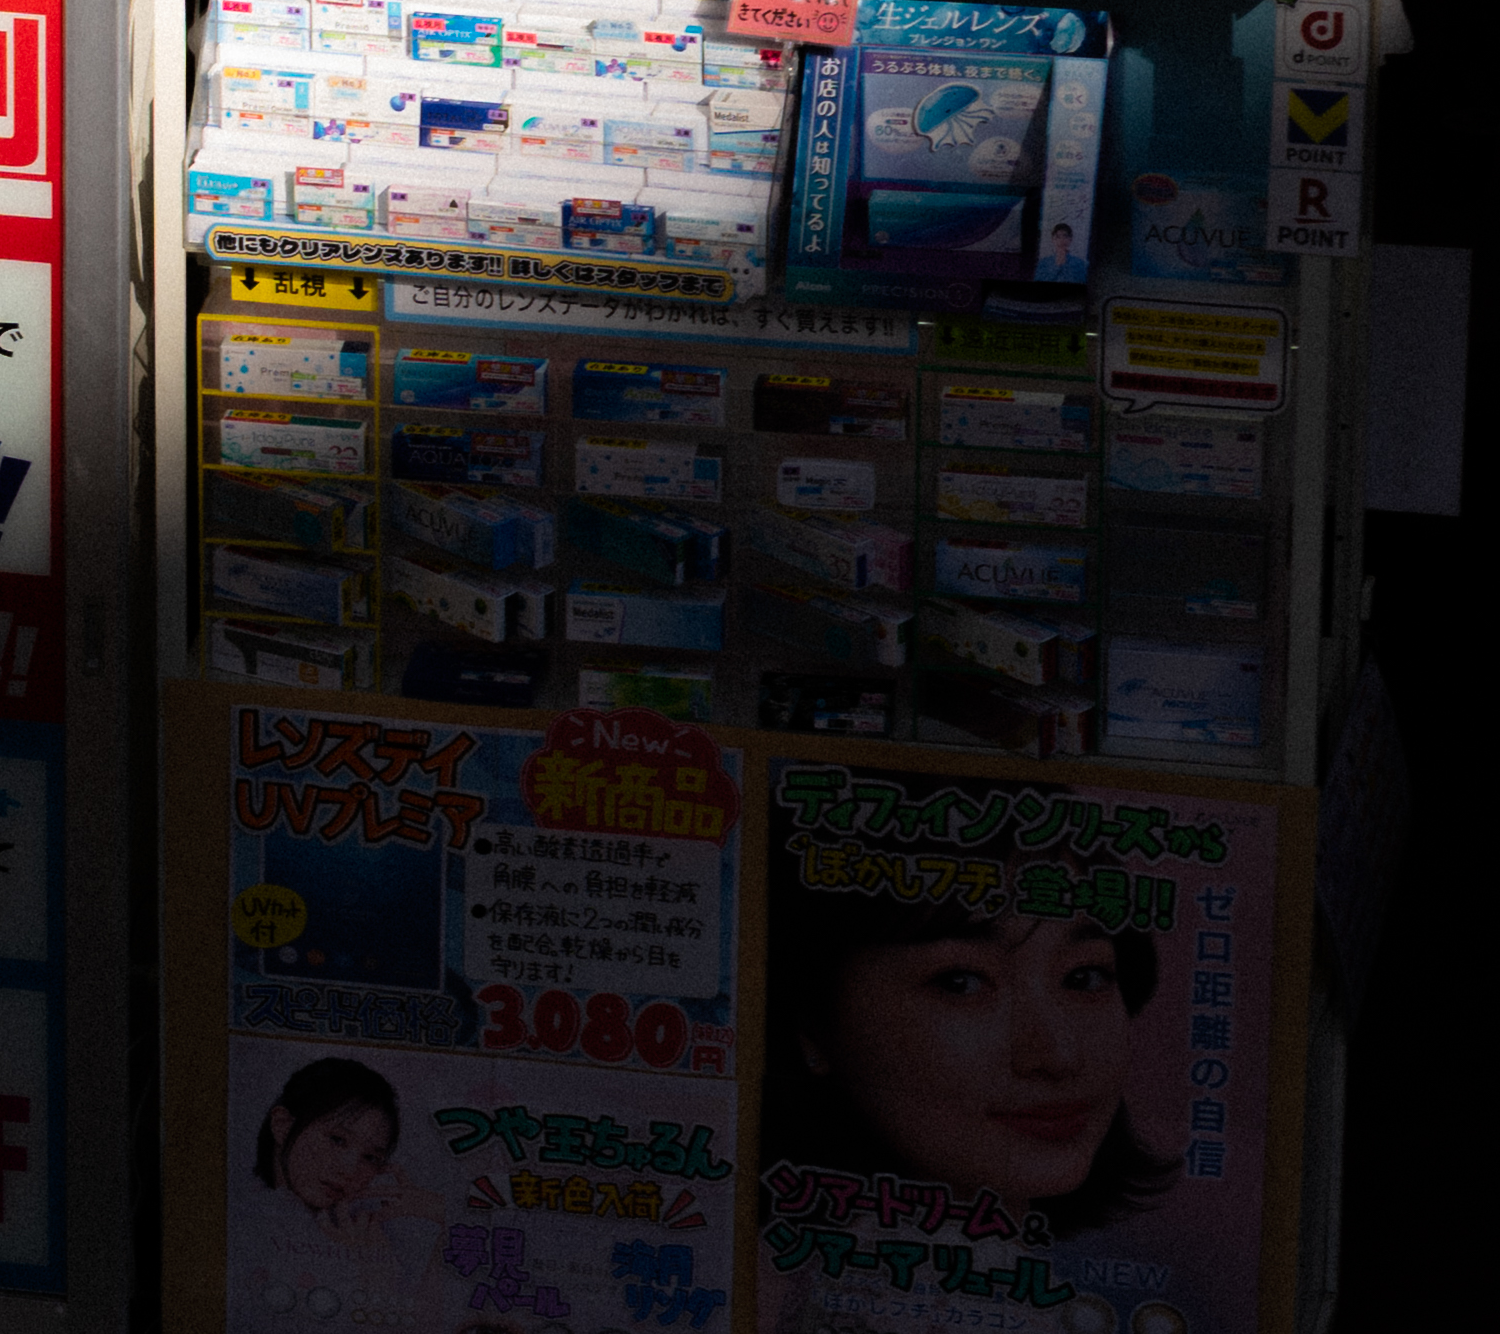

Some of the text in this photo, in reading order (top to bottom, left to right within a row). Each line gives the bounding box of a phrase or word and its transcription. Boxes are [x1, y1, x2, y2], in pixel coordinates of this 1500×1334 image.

[737, 3, 811, 30] きてください
[873, 1, 1050, 37] 生ジェルレンズ
[804, 57, 843, 254] お店の人は知ってるよ
[1285, 147, 1347, 166] POINT
[1278, 226, 1349, 249] POINT
[274, 270, 326, 298] 乱視
[961, 328, 1060, 355] 遠近両用
[237, 708, 478, 789] レンズデイ
[591, 718, 673, 755] New
[235, 778, 485, 851] UVプレミア
[534, 750, 725, 839] 新商品
[243, 896, 301, 921] UVカット
[250, 920, 279, 944] 付
[247, 985, 457, 1047] スピード価格
[1186, 885, 1235, 1178] ゼロ距離の自信
[693, 1046, 726, 1074] 円
[433, 1105, 734, 1181] つや玉ちゅるん
[509, 1168, 664, 1222] 新色入荷
[768, 1166, 1052, 1247] シアードリーム &
[443, 1222, 529, 1283] 夢見
[1081, 1258, 1172, 1290] NEW
[468, 1279, 571, 1319] パール
[624, 1282, 727, 1329] リング
